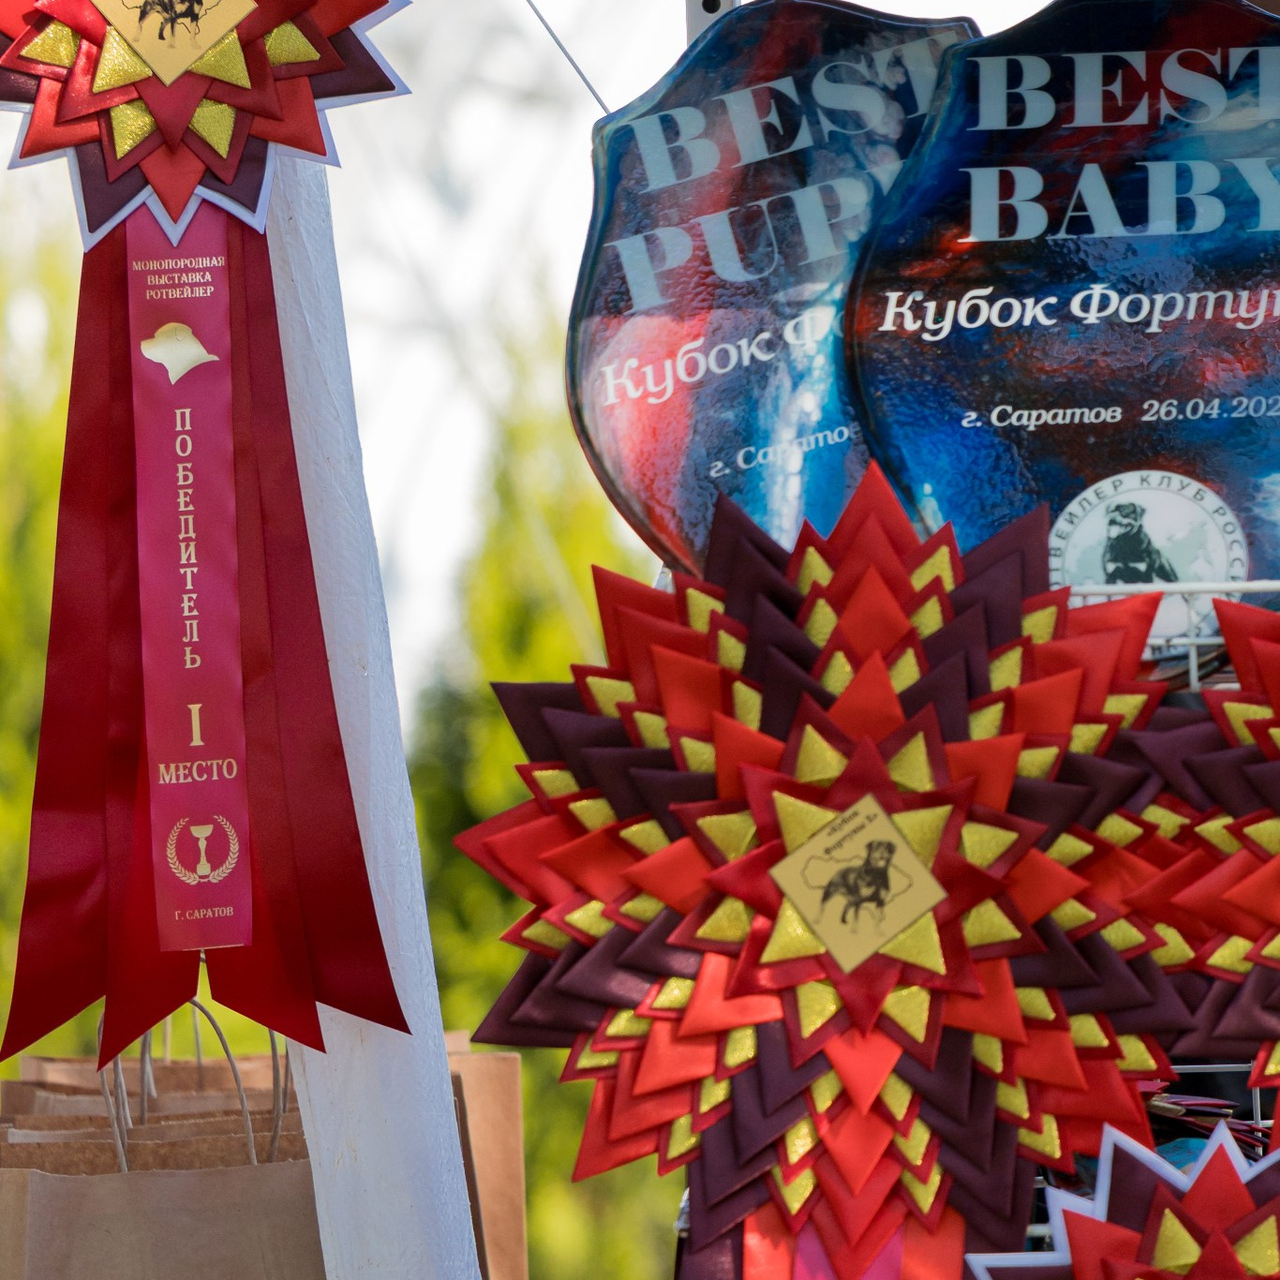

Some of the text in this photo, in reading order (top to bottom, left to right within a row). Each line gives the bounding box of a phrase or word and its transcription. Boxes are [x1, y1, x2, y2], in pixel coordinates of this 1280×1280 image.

[618, 30, 962, 195] BEST
[132, 256, 225, 271] МОНОПОРОДНАЯ
[145, 285, 214, 300] РОТВЕЙЛЕР
[147, 272, 212, 286] ВЫСТАВКА
[878, 287, 1058, 342] Кубок
[600, 332, 775, 407] Кубок
[990, 404, 1122, 432] Саратов
[174, 408, 202, 670] ПОБЕДИТЕЛЬ
[1139, 474, 1207, 502] КЛУБ
[1212, 506, 1245, 599] РОСС
[158, 758, 238, 785] МЕСТО
[186, 906, 234, 920] САРАТОВ
